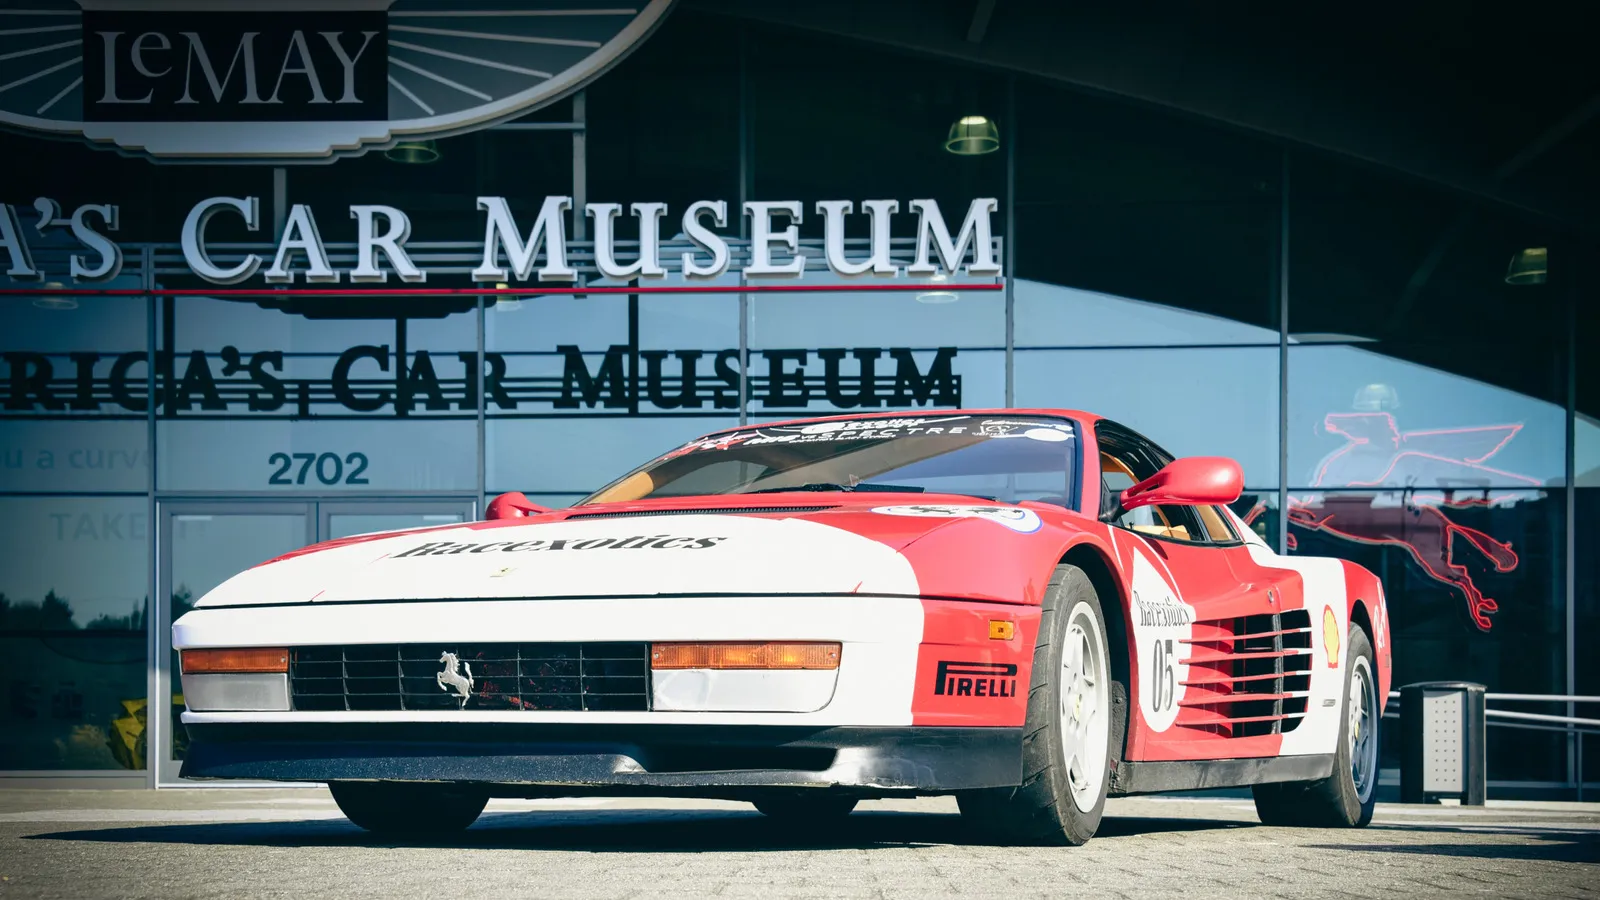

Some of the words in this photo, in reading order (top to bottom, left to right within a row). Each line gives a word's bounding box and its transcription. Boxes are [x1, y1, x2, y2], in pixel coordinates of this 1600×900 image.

[95, 29, 380, 104] LeMAY
[181, 195, 427, 284] CAR
[472, 195, 1003, 283] MUSEUM
[331, 344, 518, 412] CAR
[553, 344, 959, 411] MUSEUM
[36, 449, 56, 470] a
[268, 451, 370, 486] 2702
[49, 512, 146, 541] TAKE
[934, 660, 1018, 698] PIRELLI
[1152, 638, 1174, 713] 05
